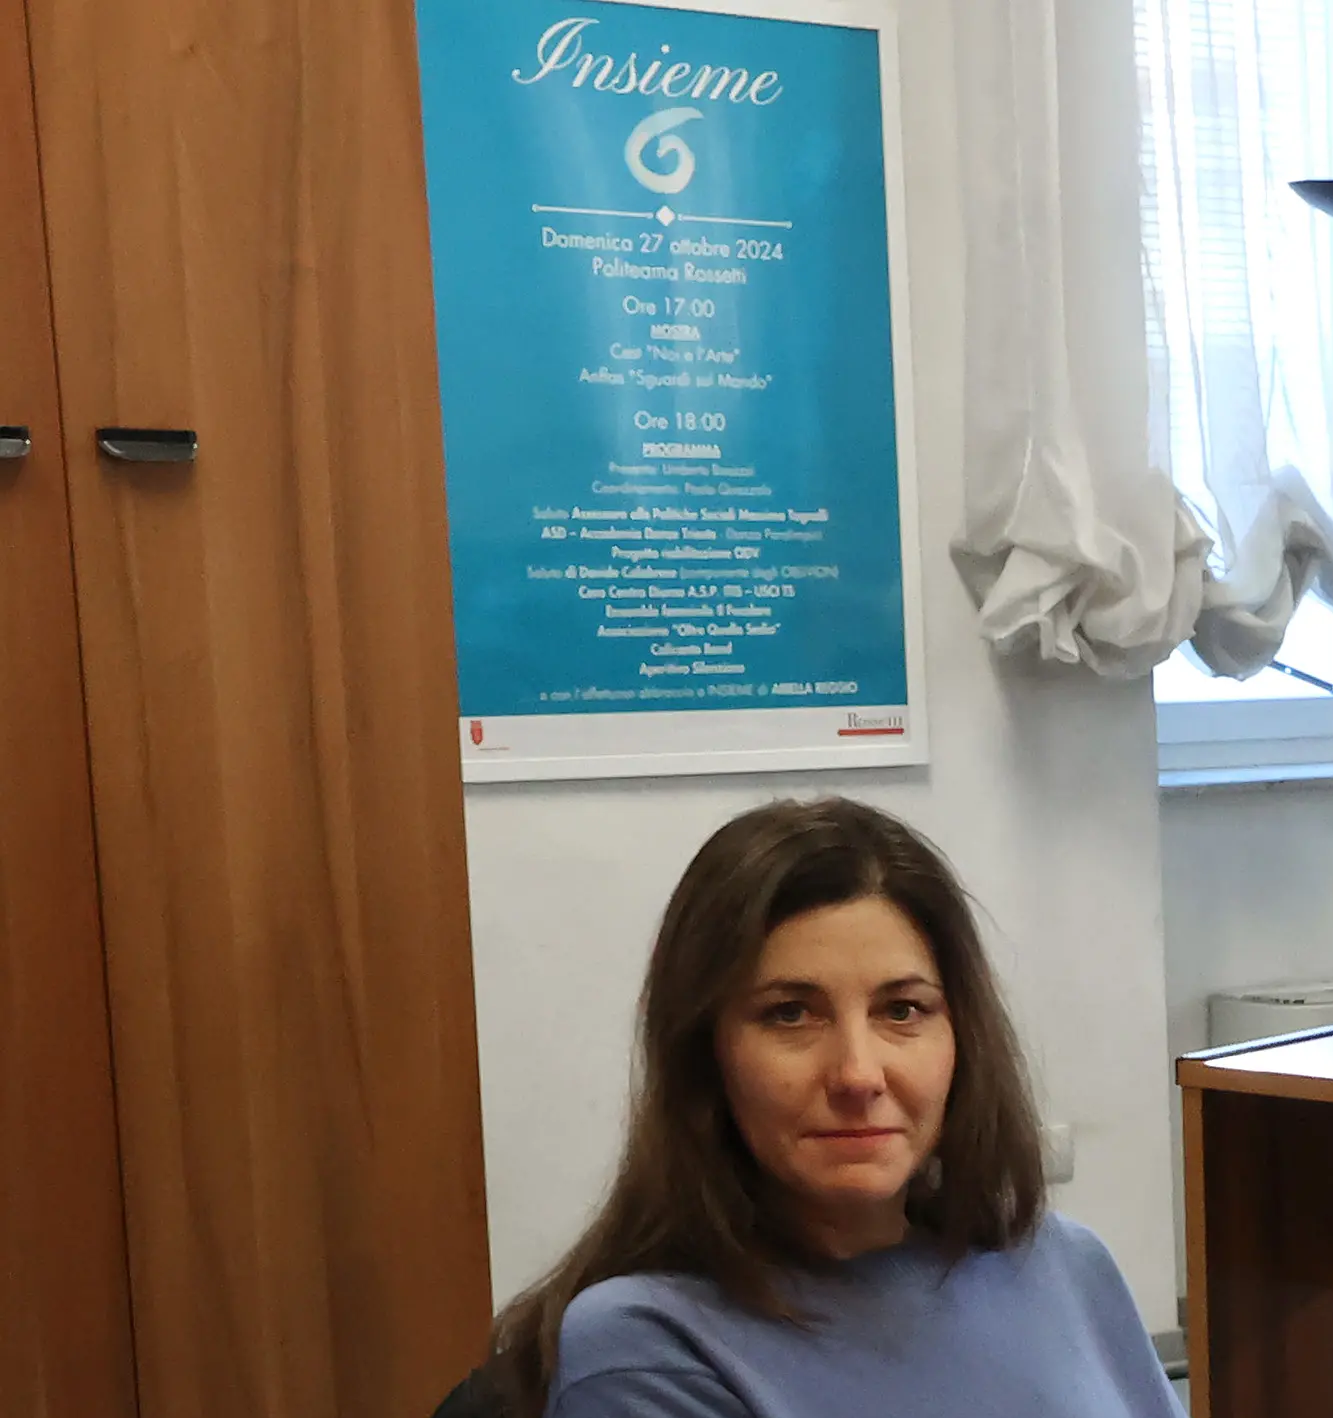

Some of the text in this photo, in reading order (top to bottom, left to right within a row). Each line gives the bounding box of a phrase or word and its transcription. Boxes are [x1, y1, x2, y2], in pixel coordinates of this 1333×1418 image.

[511, 16, 783, 105] Insieme
[541, 227, 784, 261] Domenica 27 ottobre 2024
[592, 256, 747, 285] Politeama Rossetti
[622, 295, 656, 315] Ore
[634, 411, 669, 430] Ore
